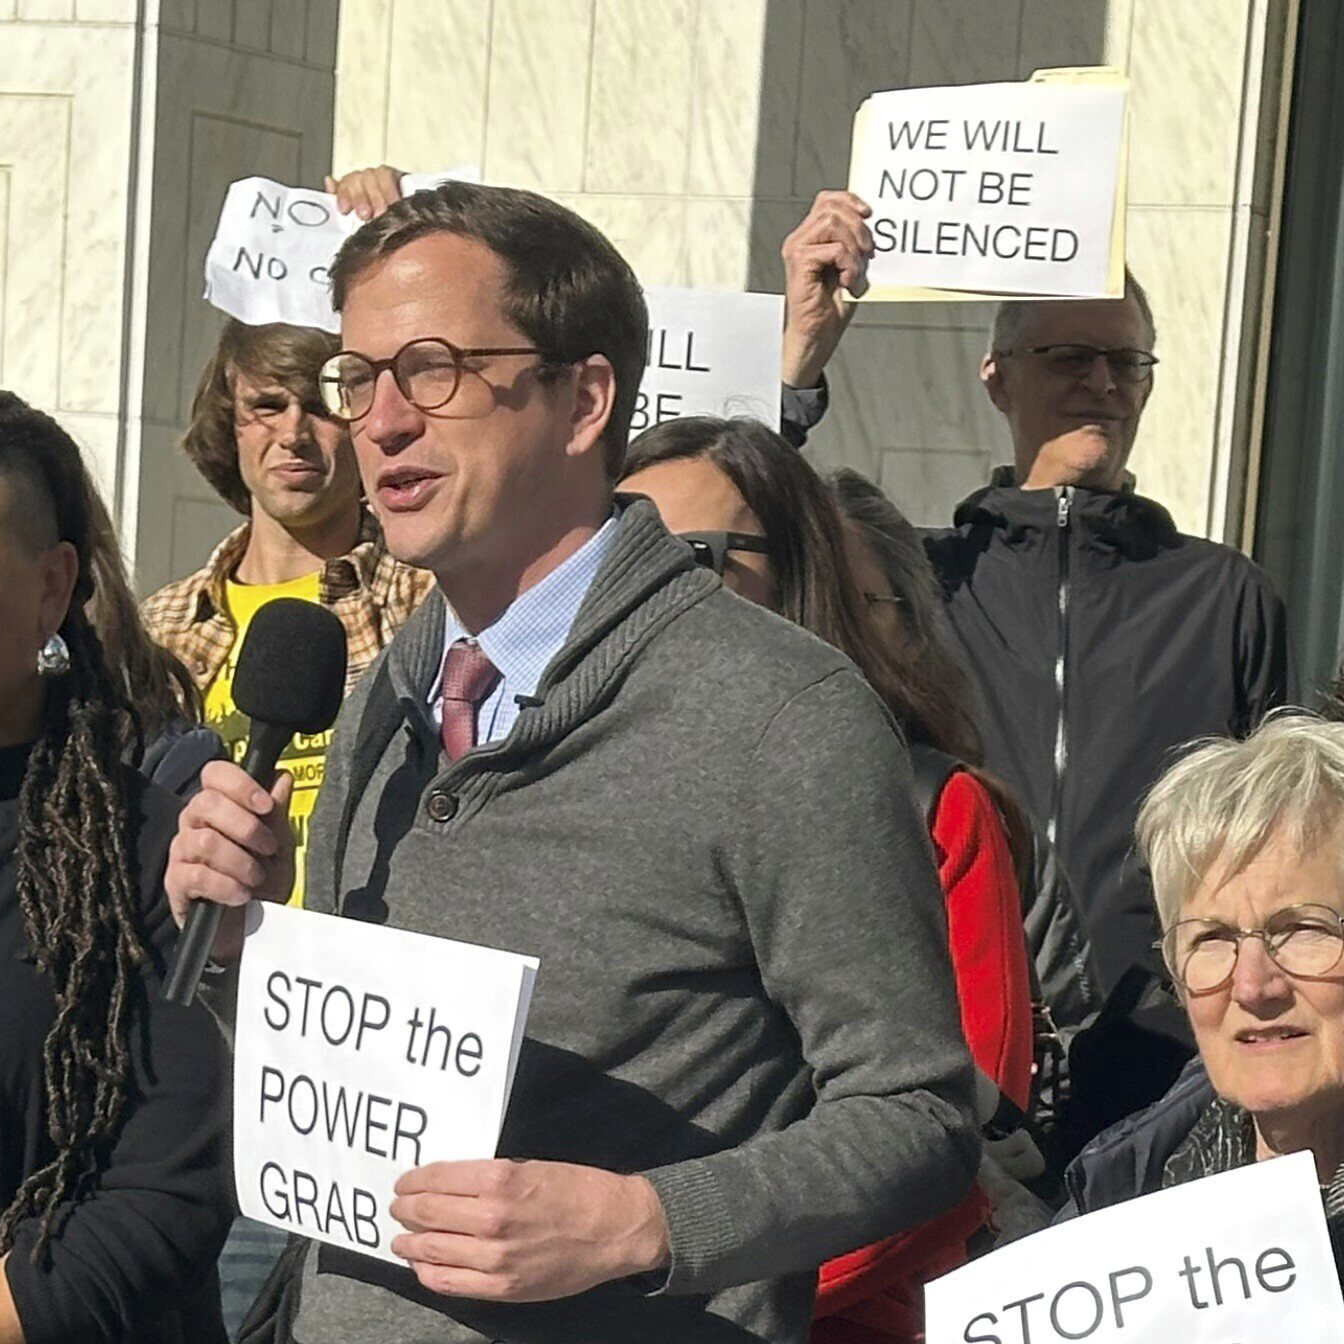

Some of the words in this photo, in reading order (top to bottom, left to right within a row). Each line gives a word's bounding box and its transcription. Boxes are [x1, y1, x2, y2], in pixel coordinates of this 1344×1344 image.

[888, 120, 950, 150] WE
[963, 120, 1059, 155] WILL
[878, 168, 967, 202] NOT
[977, 171, 1034, 206] BE
[250, 192, 330, 227] NO
[873, 218, 1079, 262] SILENCED
[233, 247, 288, 280] NO
[645, 329, 711, 372] ILL
[263, 970, 391, 1051] STOP
[406, 1006, 484, 1077] the
[259, 1065, 428, 1166] POWER
[259, 1160, 381, 1249] GRAB
[1178, 1245, 1297, 1310] the
